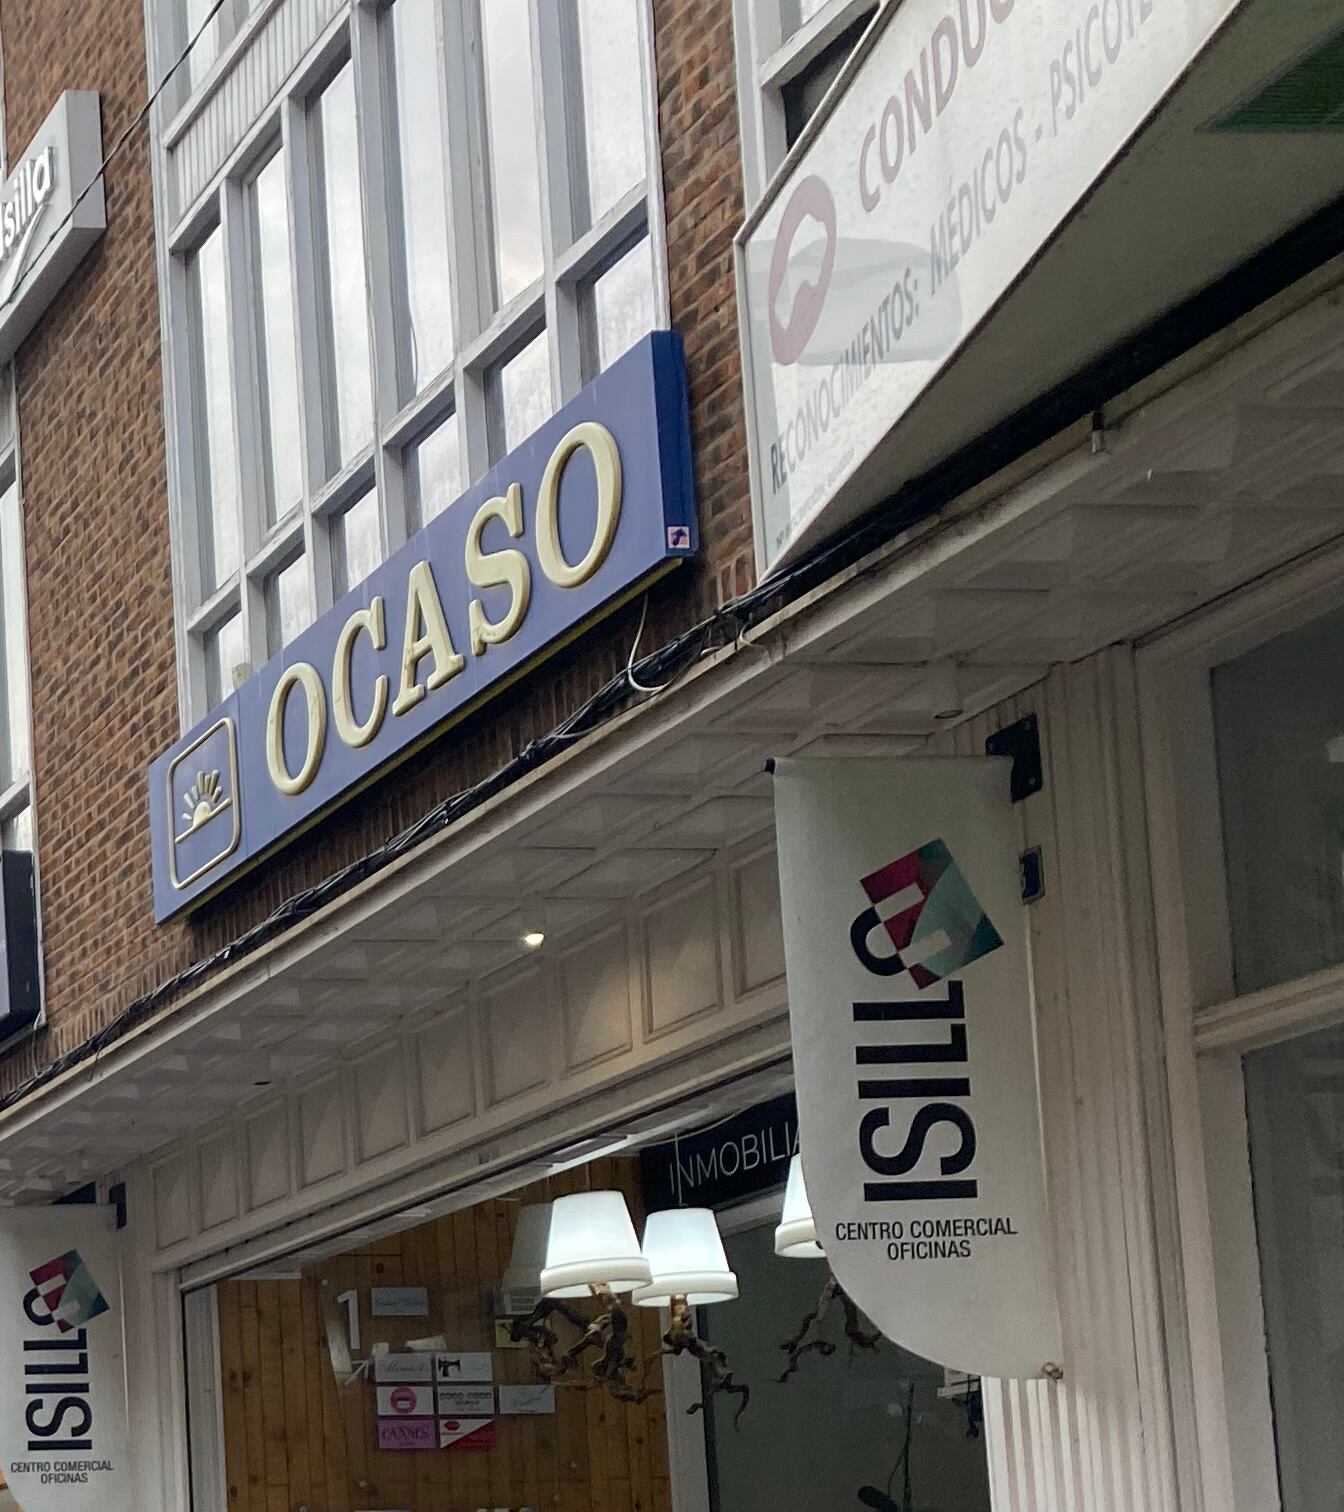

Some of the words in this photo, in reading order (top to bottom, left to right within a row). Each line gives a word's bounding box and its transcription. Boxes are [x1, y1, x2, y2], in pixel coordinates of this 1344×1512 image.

[858, 0, 1015, 213] CONDU
[770, 267, 919, 495] RECONOCIMIENTOS:
[929, 106, 1027, 296] MÉDICOS
[1050, 0, 1153, 138] PSICO
[266, 421, 622, 797] OCASO
[835, 1221, 904, 1241] CENTRO
[909, 1217, 1019, 1239] COMERCIAL
[887, 1239, 972, 1261] OFICINAS
[336, 1289, 361, 1350] 1
[10, 1461, 51, 1472] CENTRO
[53, 1460, 114, 1471] COMERCIAL
[40, 1473, 88, 1483] OFICINAS
